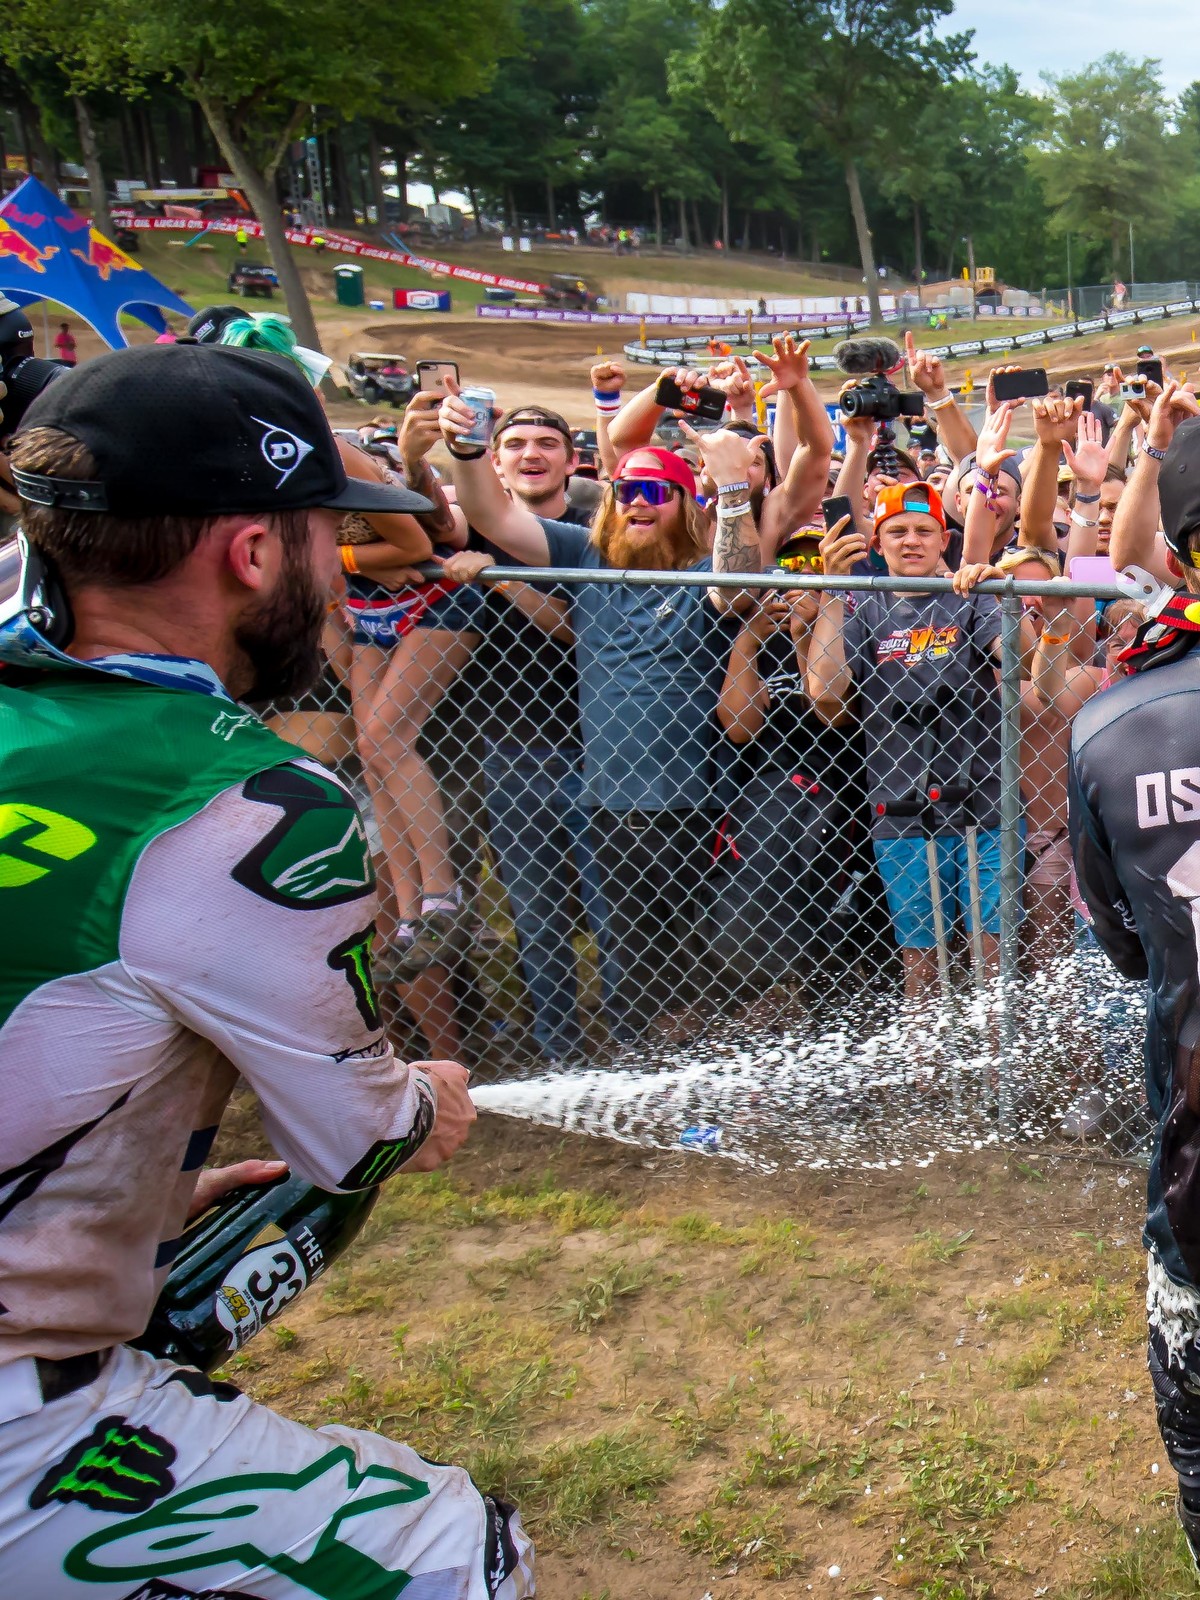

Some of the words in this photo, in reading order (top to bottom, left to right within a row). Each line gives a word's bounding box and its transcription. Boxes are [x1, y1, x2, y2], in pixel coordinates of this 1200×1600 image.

[153, 219, 186, 229] LUCAS
[452, 267, 482, 281] LUCAS
[878, 638, 910, 650] SOUTH
[296, 1225, 324, 1268] THE
[221, 1285, 251, 1320] 450
